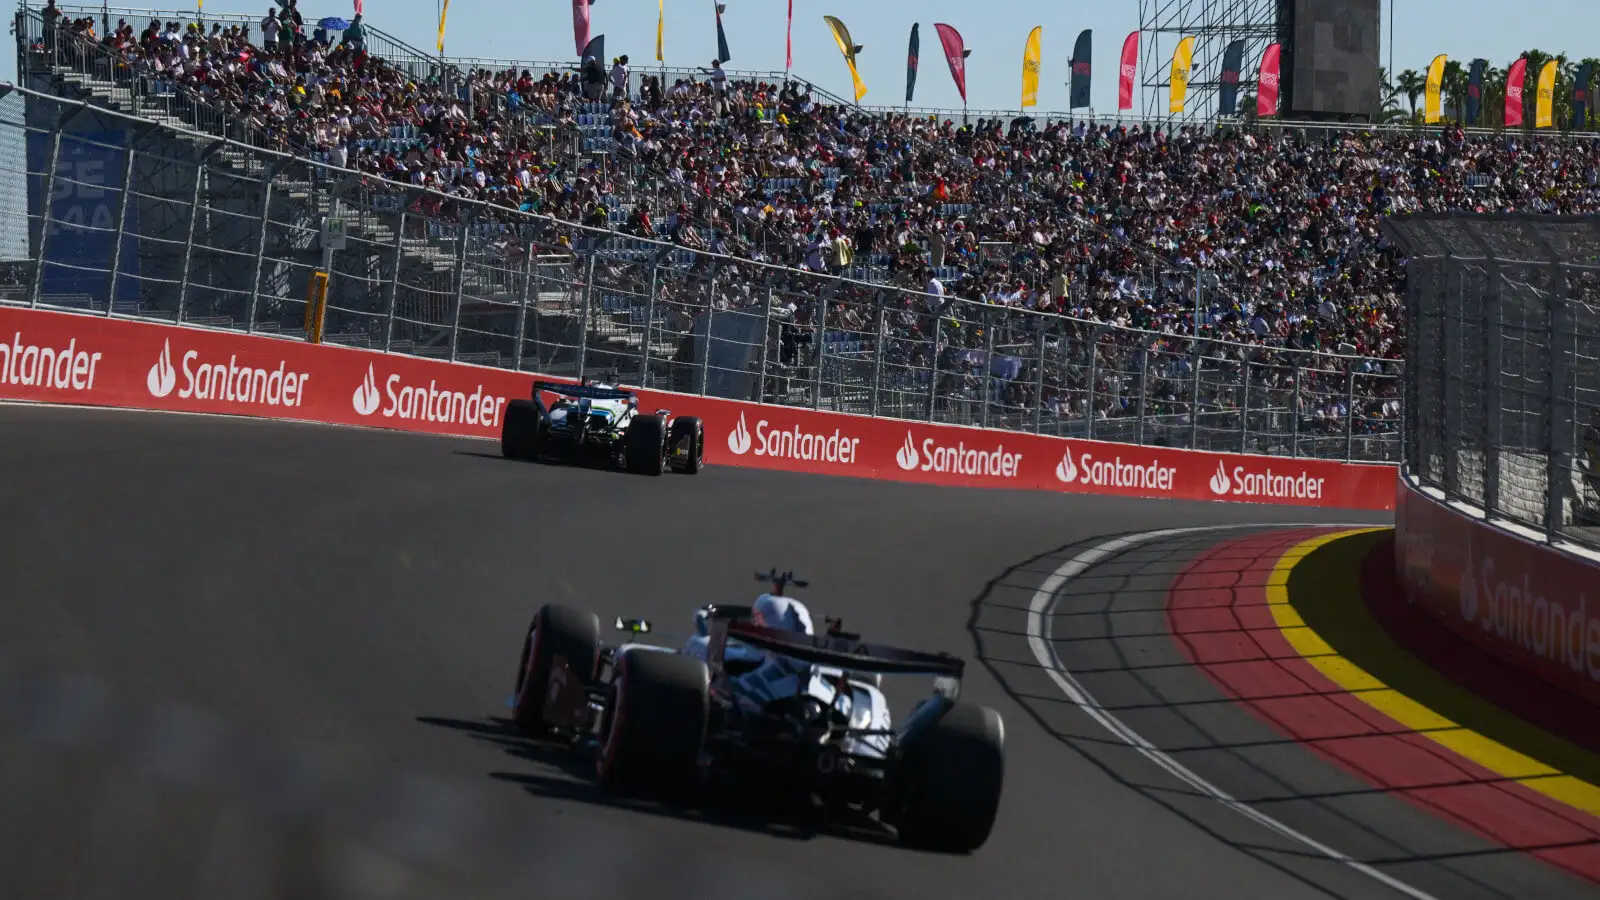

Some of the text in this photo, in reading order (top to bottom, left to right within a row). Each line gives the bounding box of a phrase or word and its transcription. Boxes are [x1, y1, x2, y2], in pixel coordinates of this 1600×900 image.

[179, 350, 309, 407] Santander
[383, 374, 506, 427] Santander
[755, 420, 860, 464] Santander
[921, 438, 1022, 477] Santander
[1081, 454, 1177, 490] Santander
[1233, 467, 1325, 499] Santander
